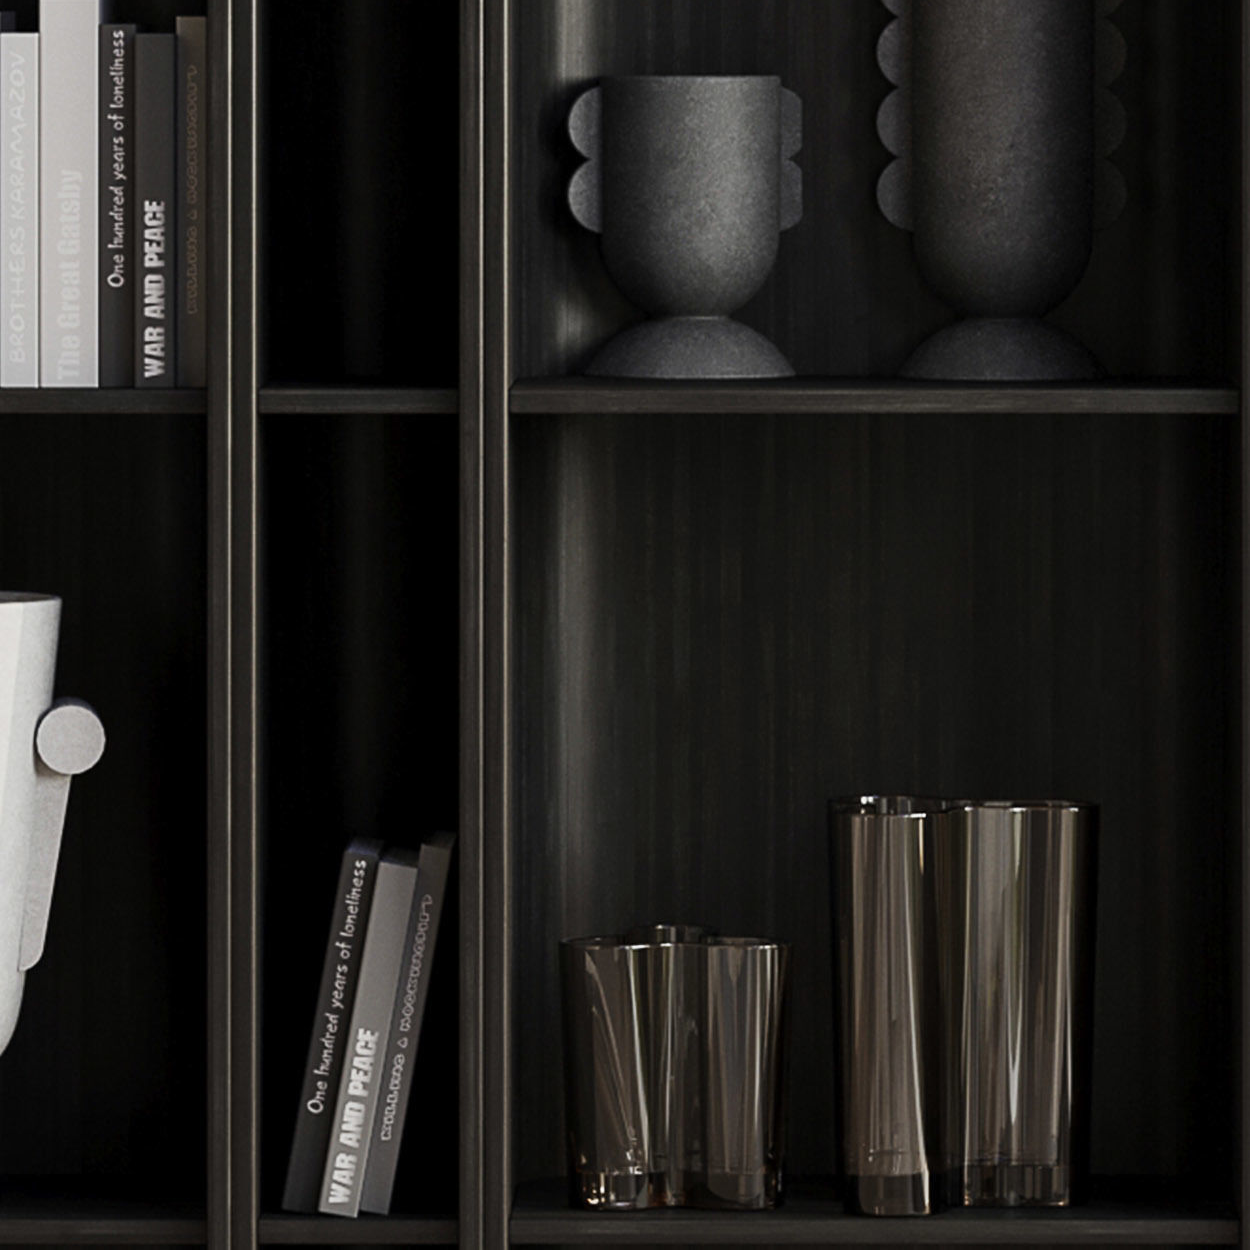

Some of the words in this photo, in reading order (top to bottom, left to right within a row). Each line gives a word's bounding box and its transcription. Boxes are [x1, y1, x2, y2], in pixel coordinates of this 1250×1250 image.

[109, 30, 124, 109] loneliness
[108, 114, 124, 131] of
[112, 136, 127, 181] years
[57, 168, 83, 255] Gatsby
[108, 186, 124, 249] hundred
[144, 200, 165, 267] PEACE
[57, 261, 80, 328] Great
[107, 254, 124, 287] One
[144, 274, 165, 319] AND
[57, 334, 80, 380] The
[144, 327, 165, 378] WAR
[339, 859, 367, 938] loneliness
[335, 942, 350, 960] of
[329, 965, 348, 1009] years
[314, 1014, 339, 1075] hundred
[348, 1028, 379, 1097] PEACE
[307, 1081, 328, 1114] One
[340, 1102, 366, 1148] AND
[328, 1153, 358, 1204] WAR
